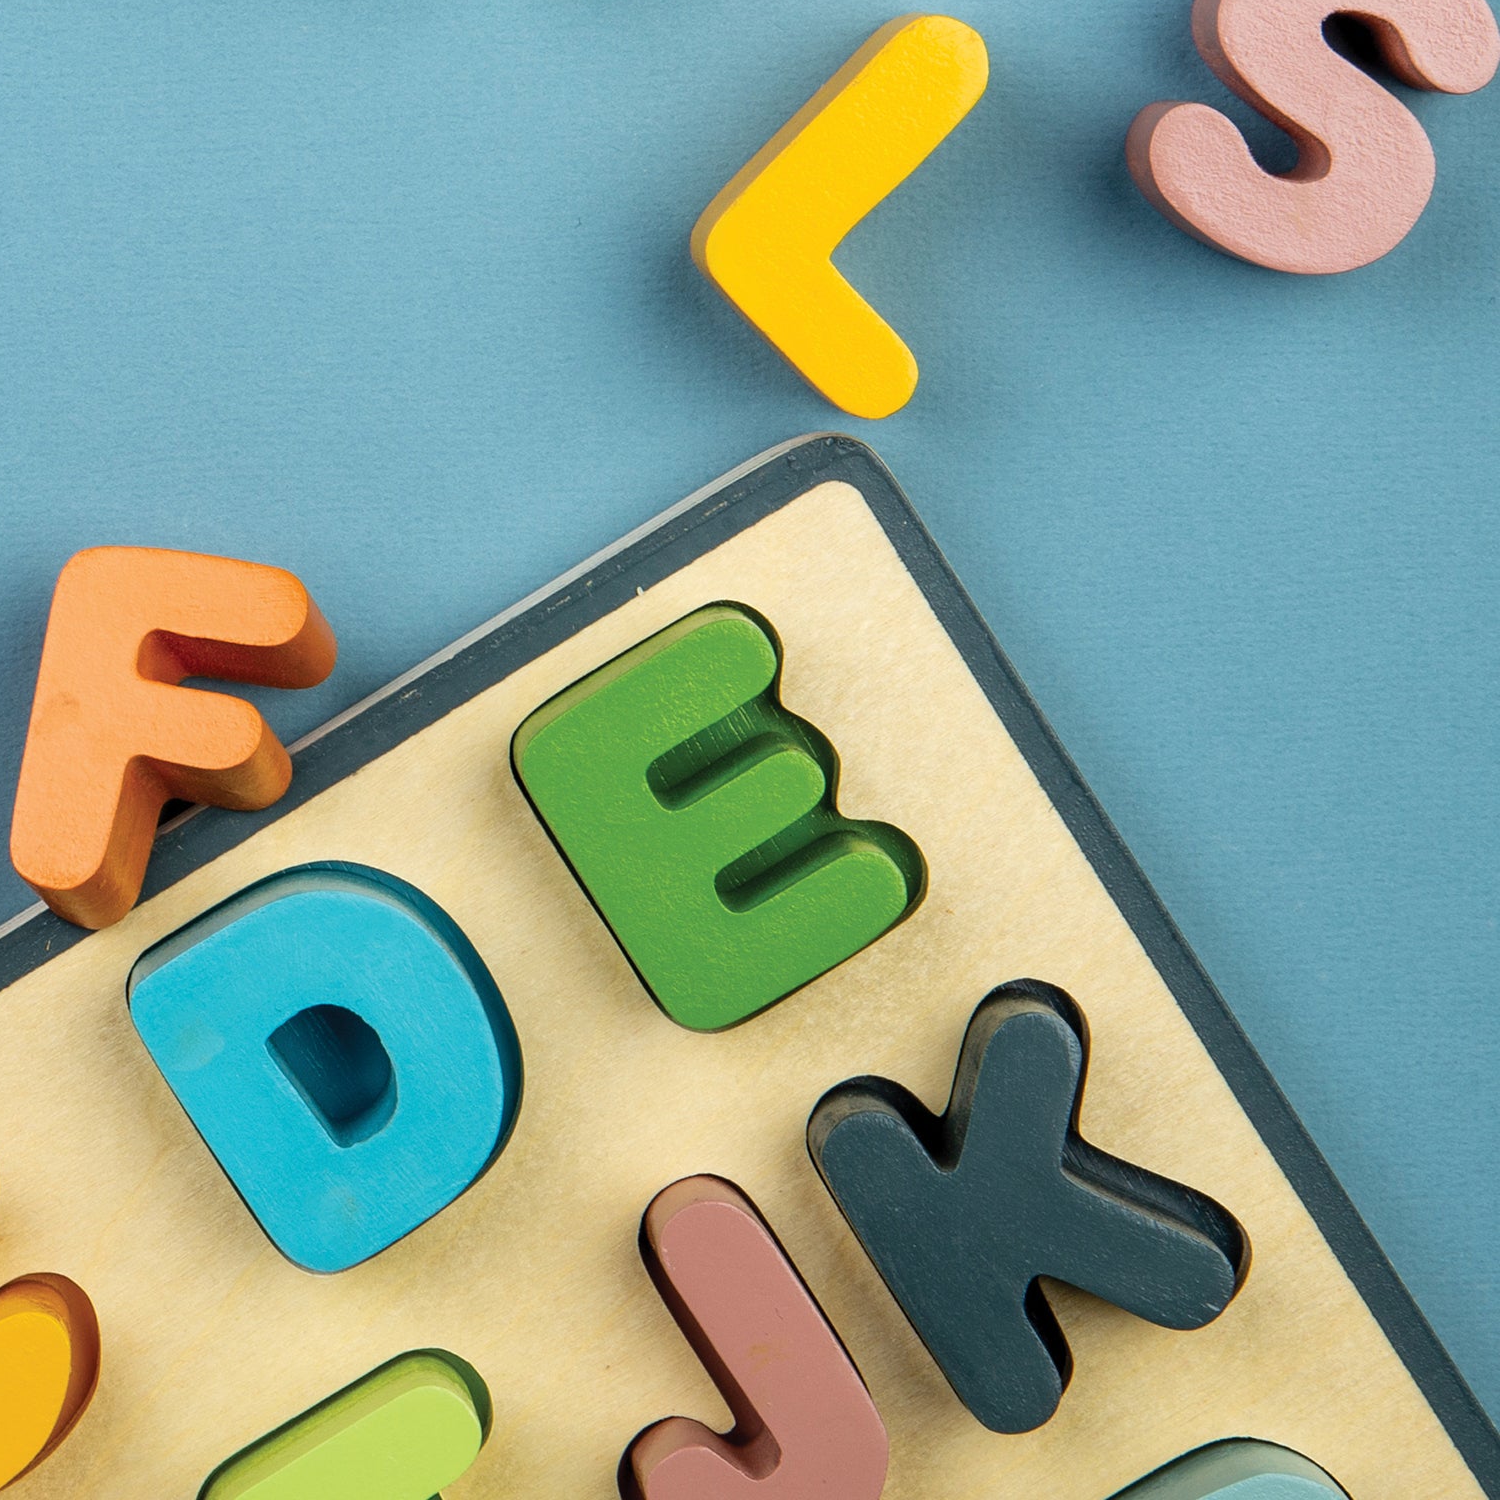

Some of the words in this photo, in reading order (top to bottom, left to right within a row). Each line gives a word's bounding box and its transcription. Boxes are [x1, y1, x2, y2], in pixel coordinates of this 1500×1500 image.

[11, 545, 337, 929] F
[130, 868, 518, 1275] D
[513, 604, 918, 1032] E
[812, 984, 1245, 1434] K
